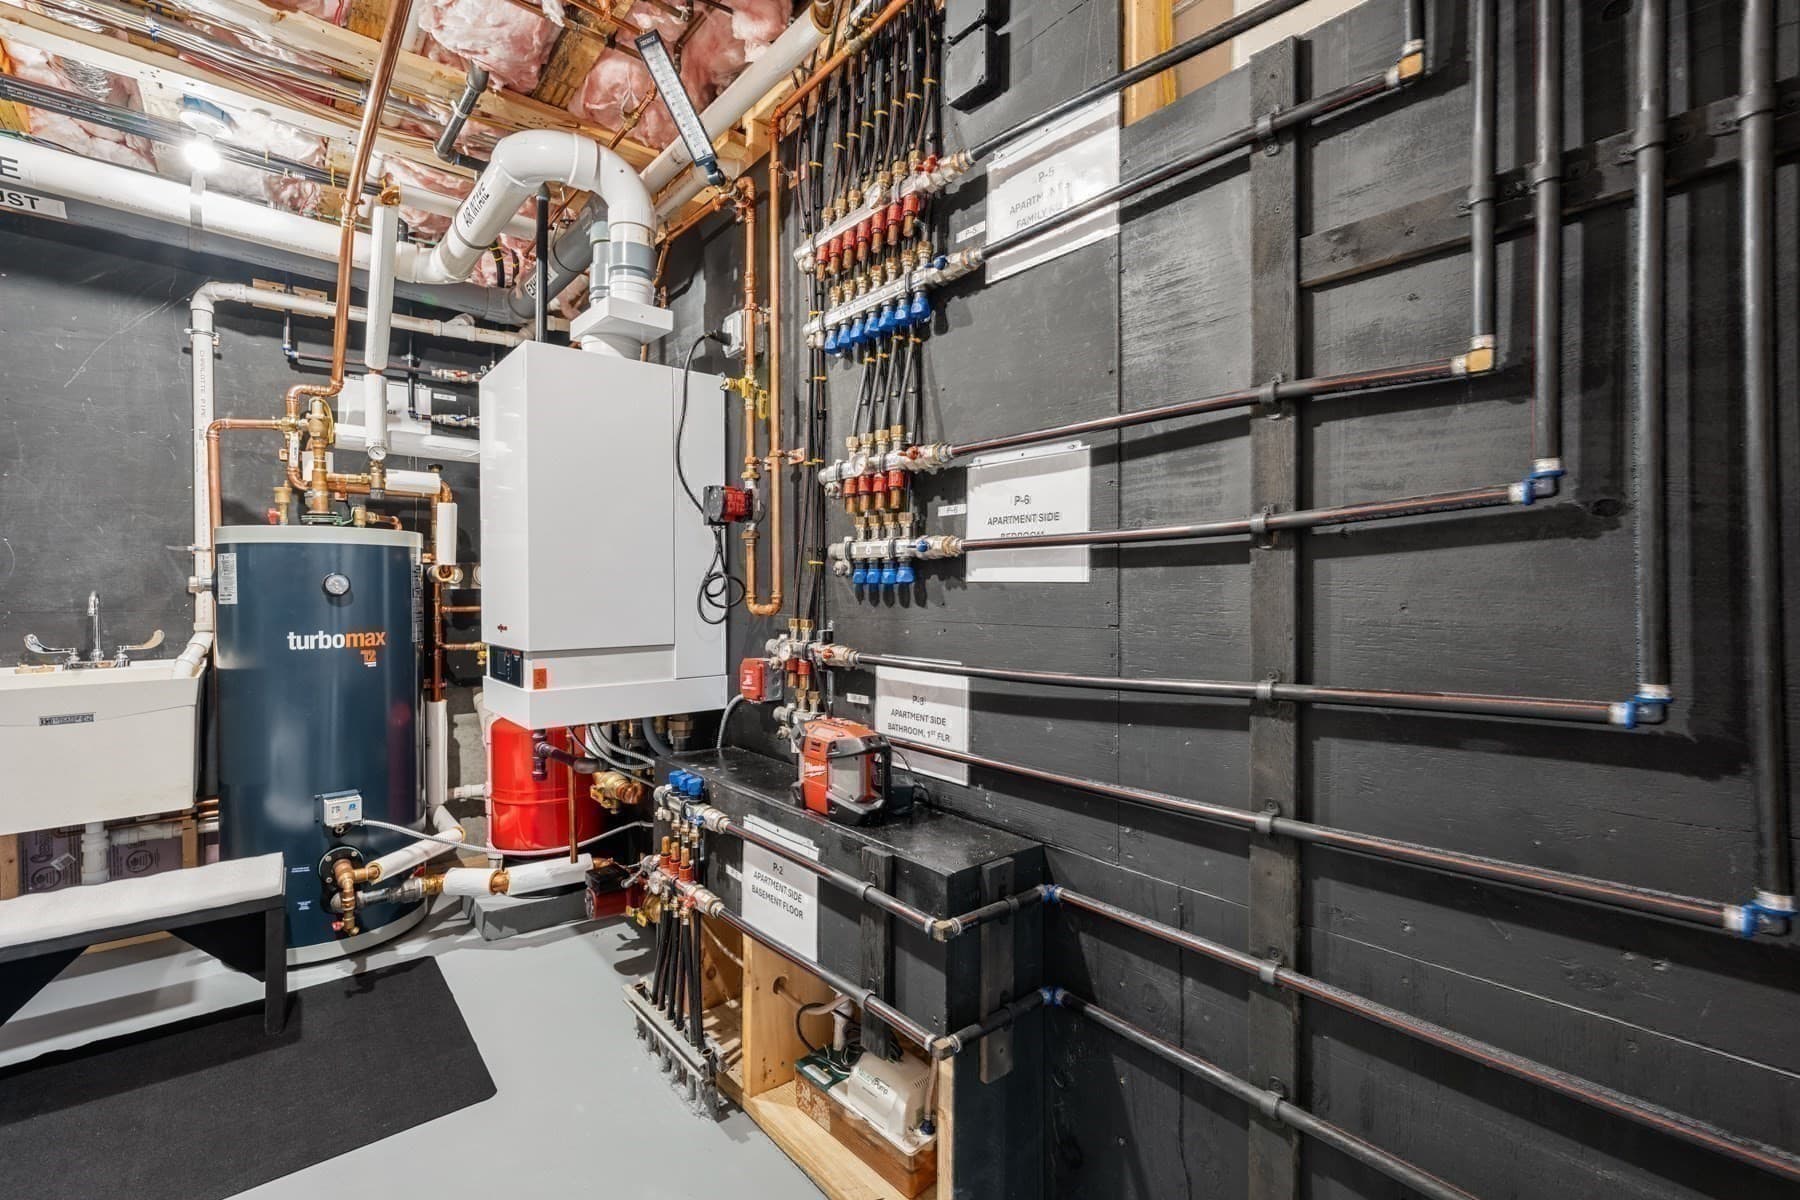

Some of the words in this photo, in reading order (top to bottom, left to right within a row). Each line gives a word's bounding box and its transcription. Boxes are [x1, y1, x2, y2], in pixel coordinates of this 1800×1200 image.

[1014, 494, 1031, 506] P-6
[987, 513, 1037, 526] APARTMENT
[1038, 511, 1060, 522] SIDE
[287, 630, 386, 651] turbomax
[891, 708, 929, 723] APARTMENT
[930, 716, 947, 727] SIDE
[937, 732, 951, 743] FLR
[773, 862, 784, 875] P-2
[753, 871, 788, 897] APARTMENT
[788, 888, 803, 904] SIDE
[751, 884, 783, 908] BASEMENT
[782, 901, 804, 919] FLOOR
